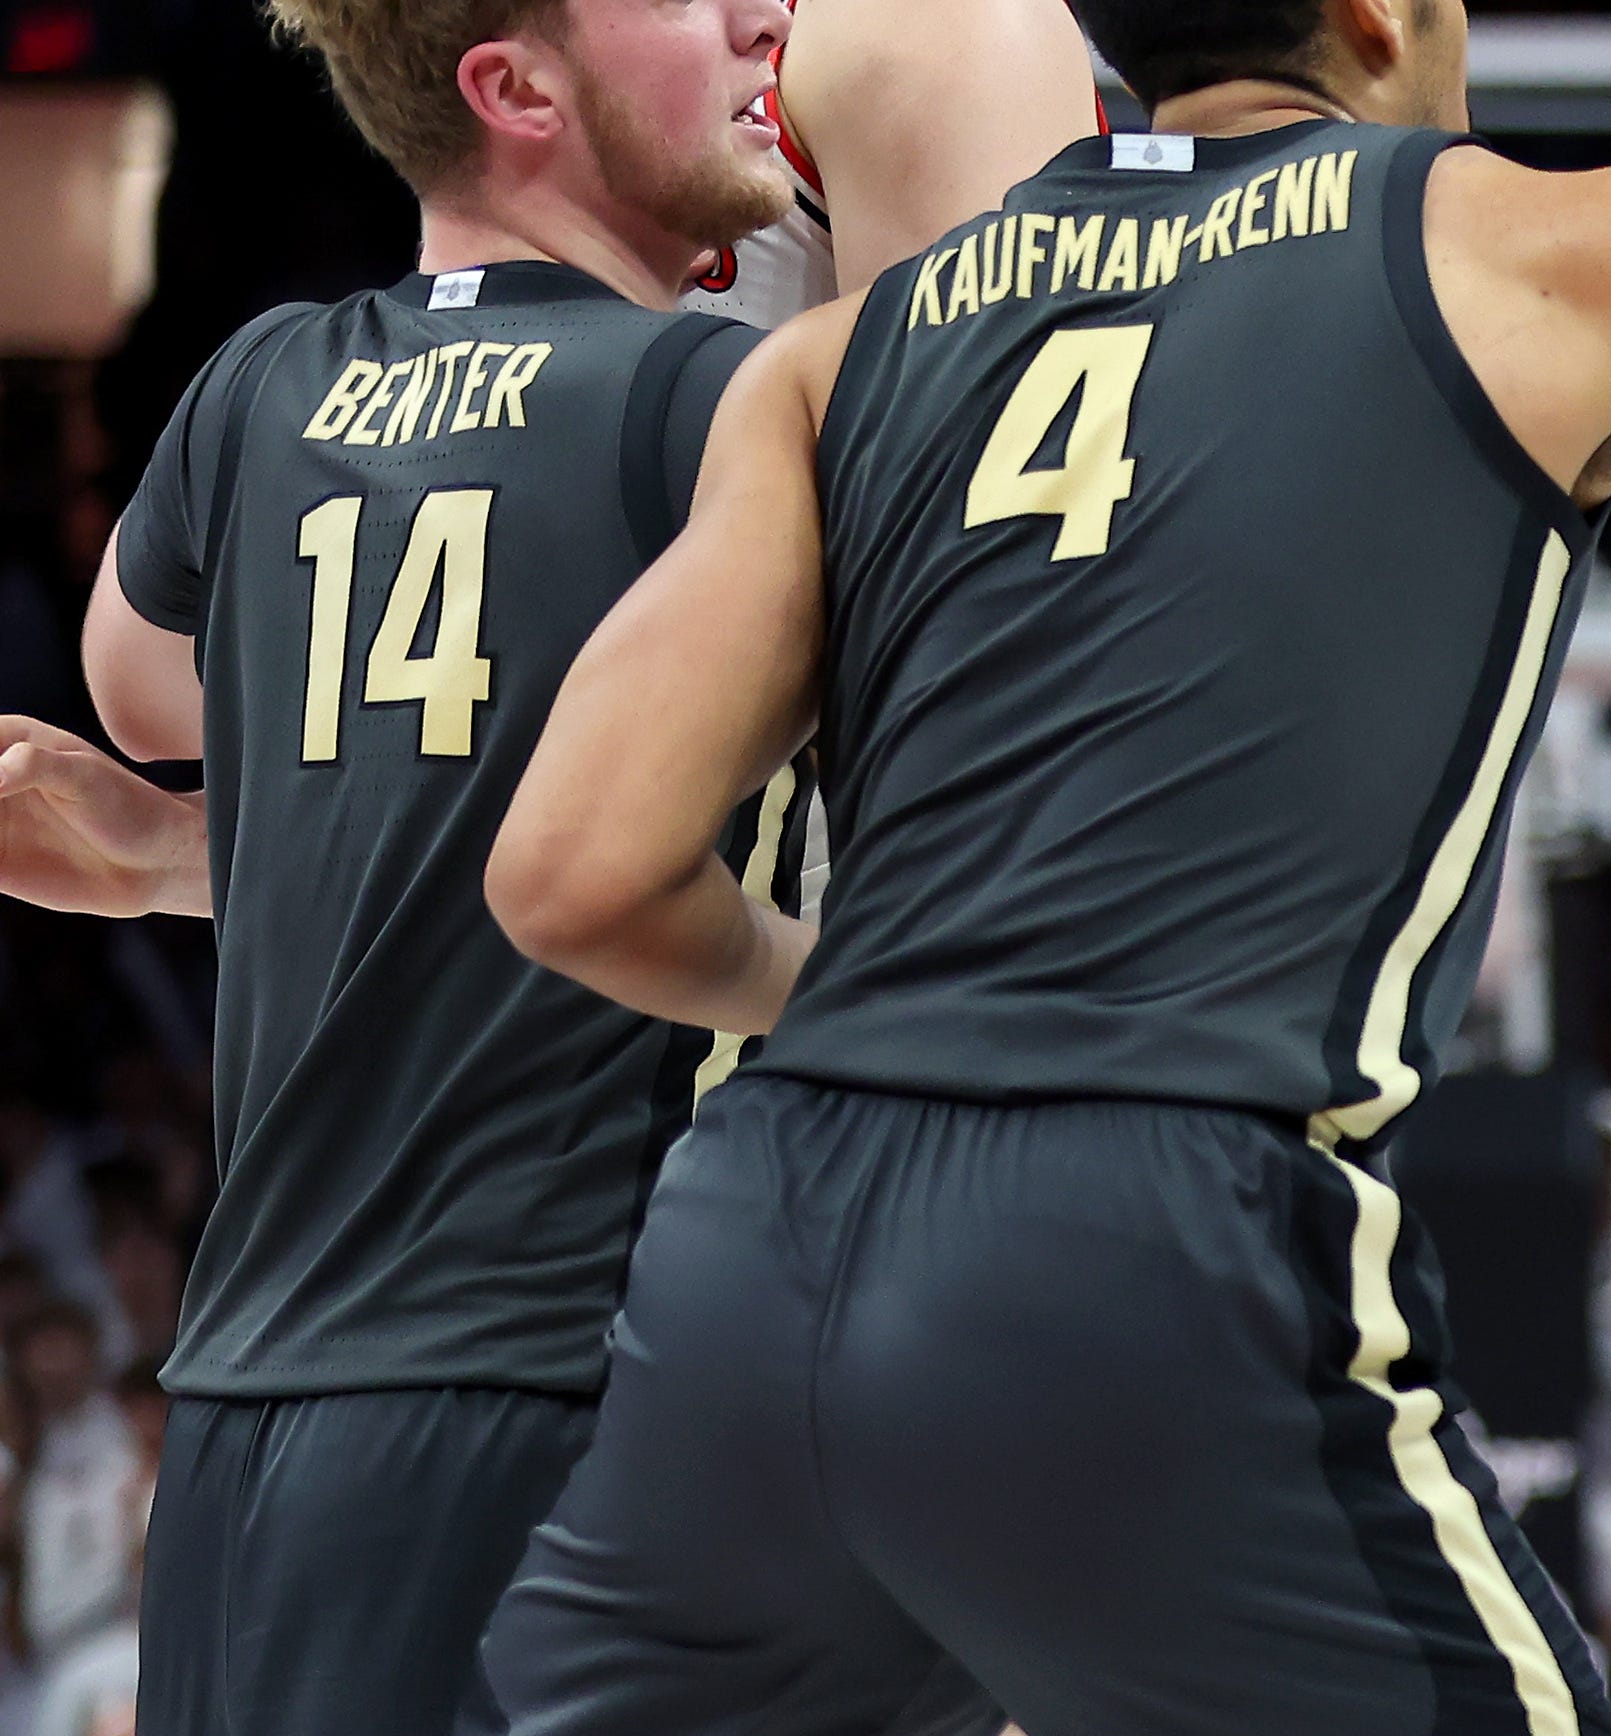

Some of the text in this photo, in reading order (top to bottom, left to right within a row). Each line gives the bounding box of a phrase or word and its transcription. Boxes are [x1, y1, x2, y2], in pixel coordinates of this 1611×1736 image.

[907, 149, 1359, 333] KAUFMAN-RENN
[301, 340, 554, 449] BENTER
[963, 322, 1155, 564] 4
[297, 483, 495, 764] 14
